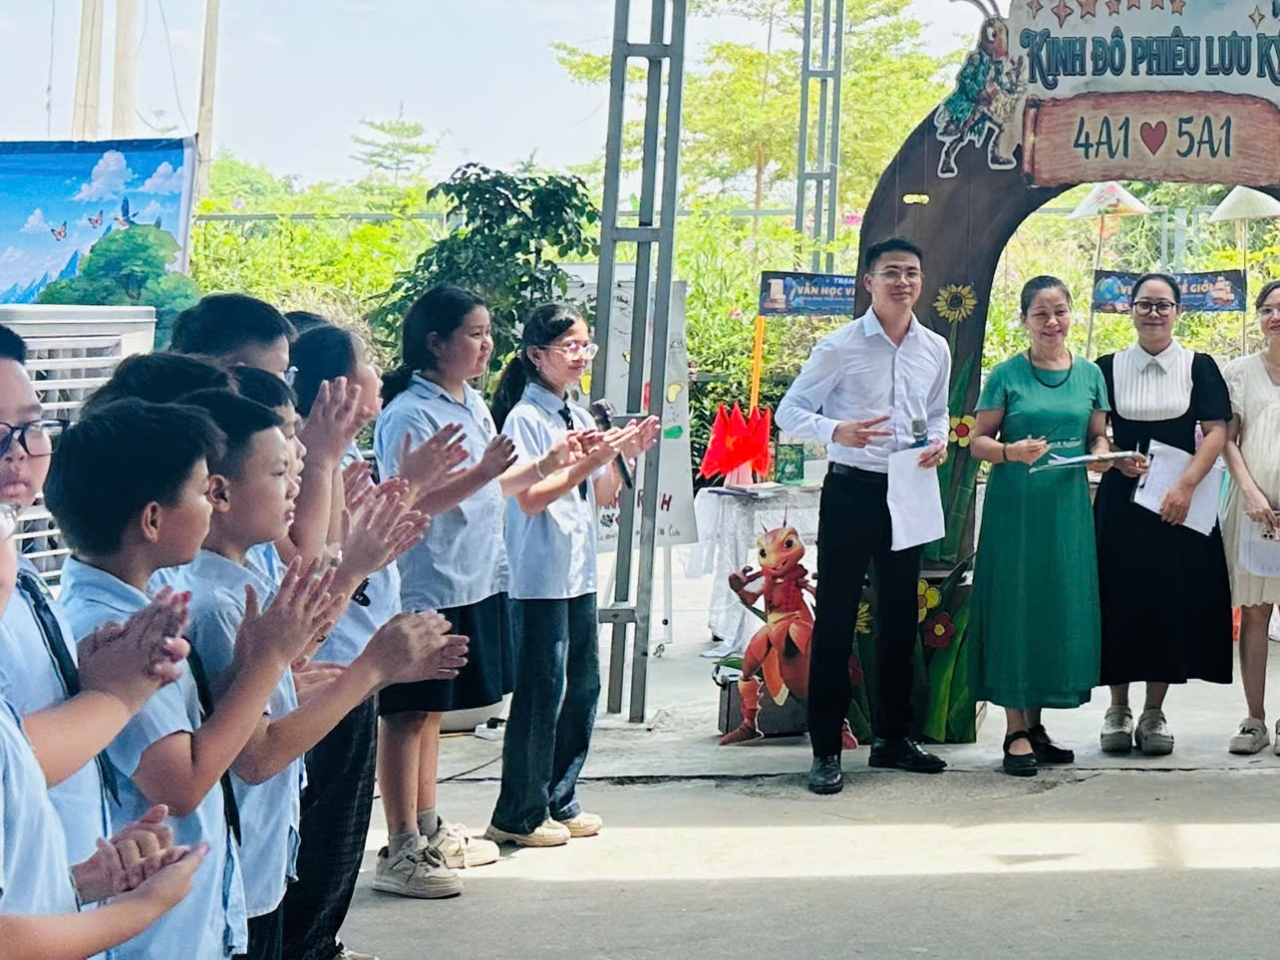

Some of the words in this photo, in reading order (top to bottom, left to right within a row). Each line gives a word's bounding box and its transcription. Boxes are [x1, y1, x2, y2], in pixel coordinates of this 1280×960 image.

[1019, 28, 1087, 90] KINH
[1091, 26, 1126, 76] ĐÔ
[1131, 26, 1201, 76] PHIÊU
[1073, 116, 1130, 159] 4A1
[1176, 116, 1232, 159] 5A1
[821, 287, 841, 298] HỌC
